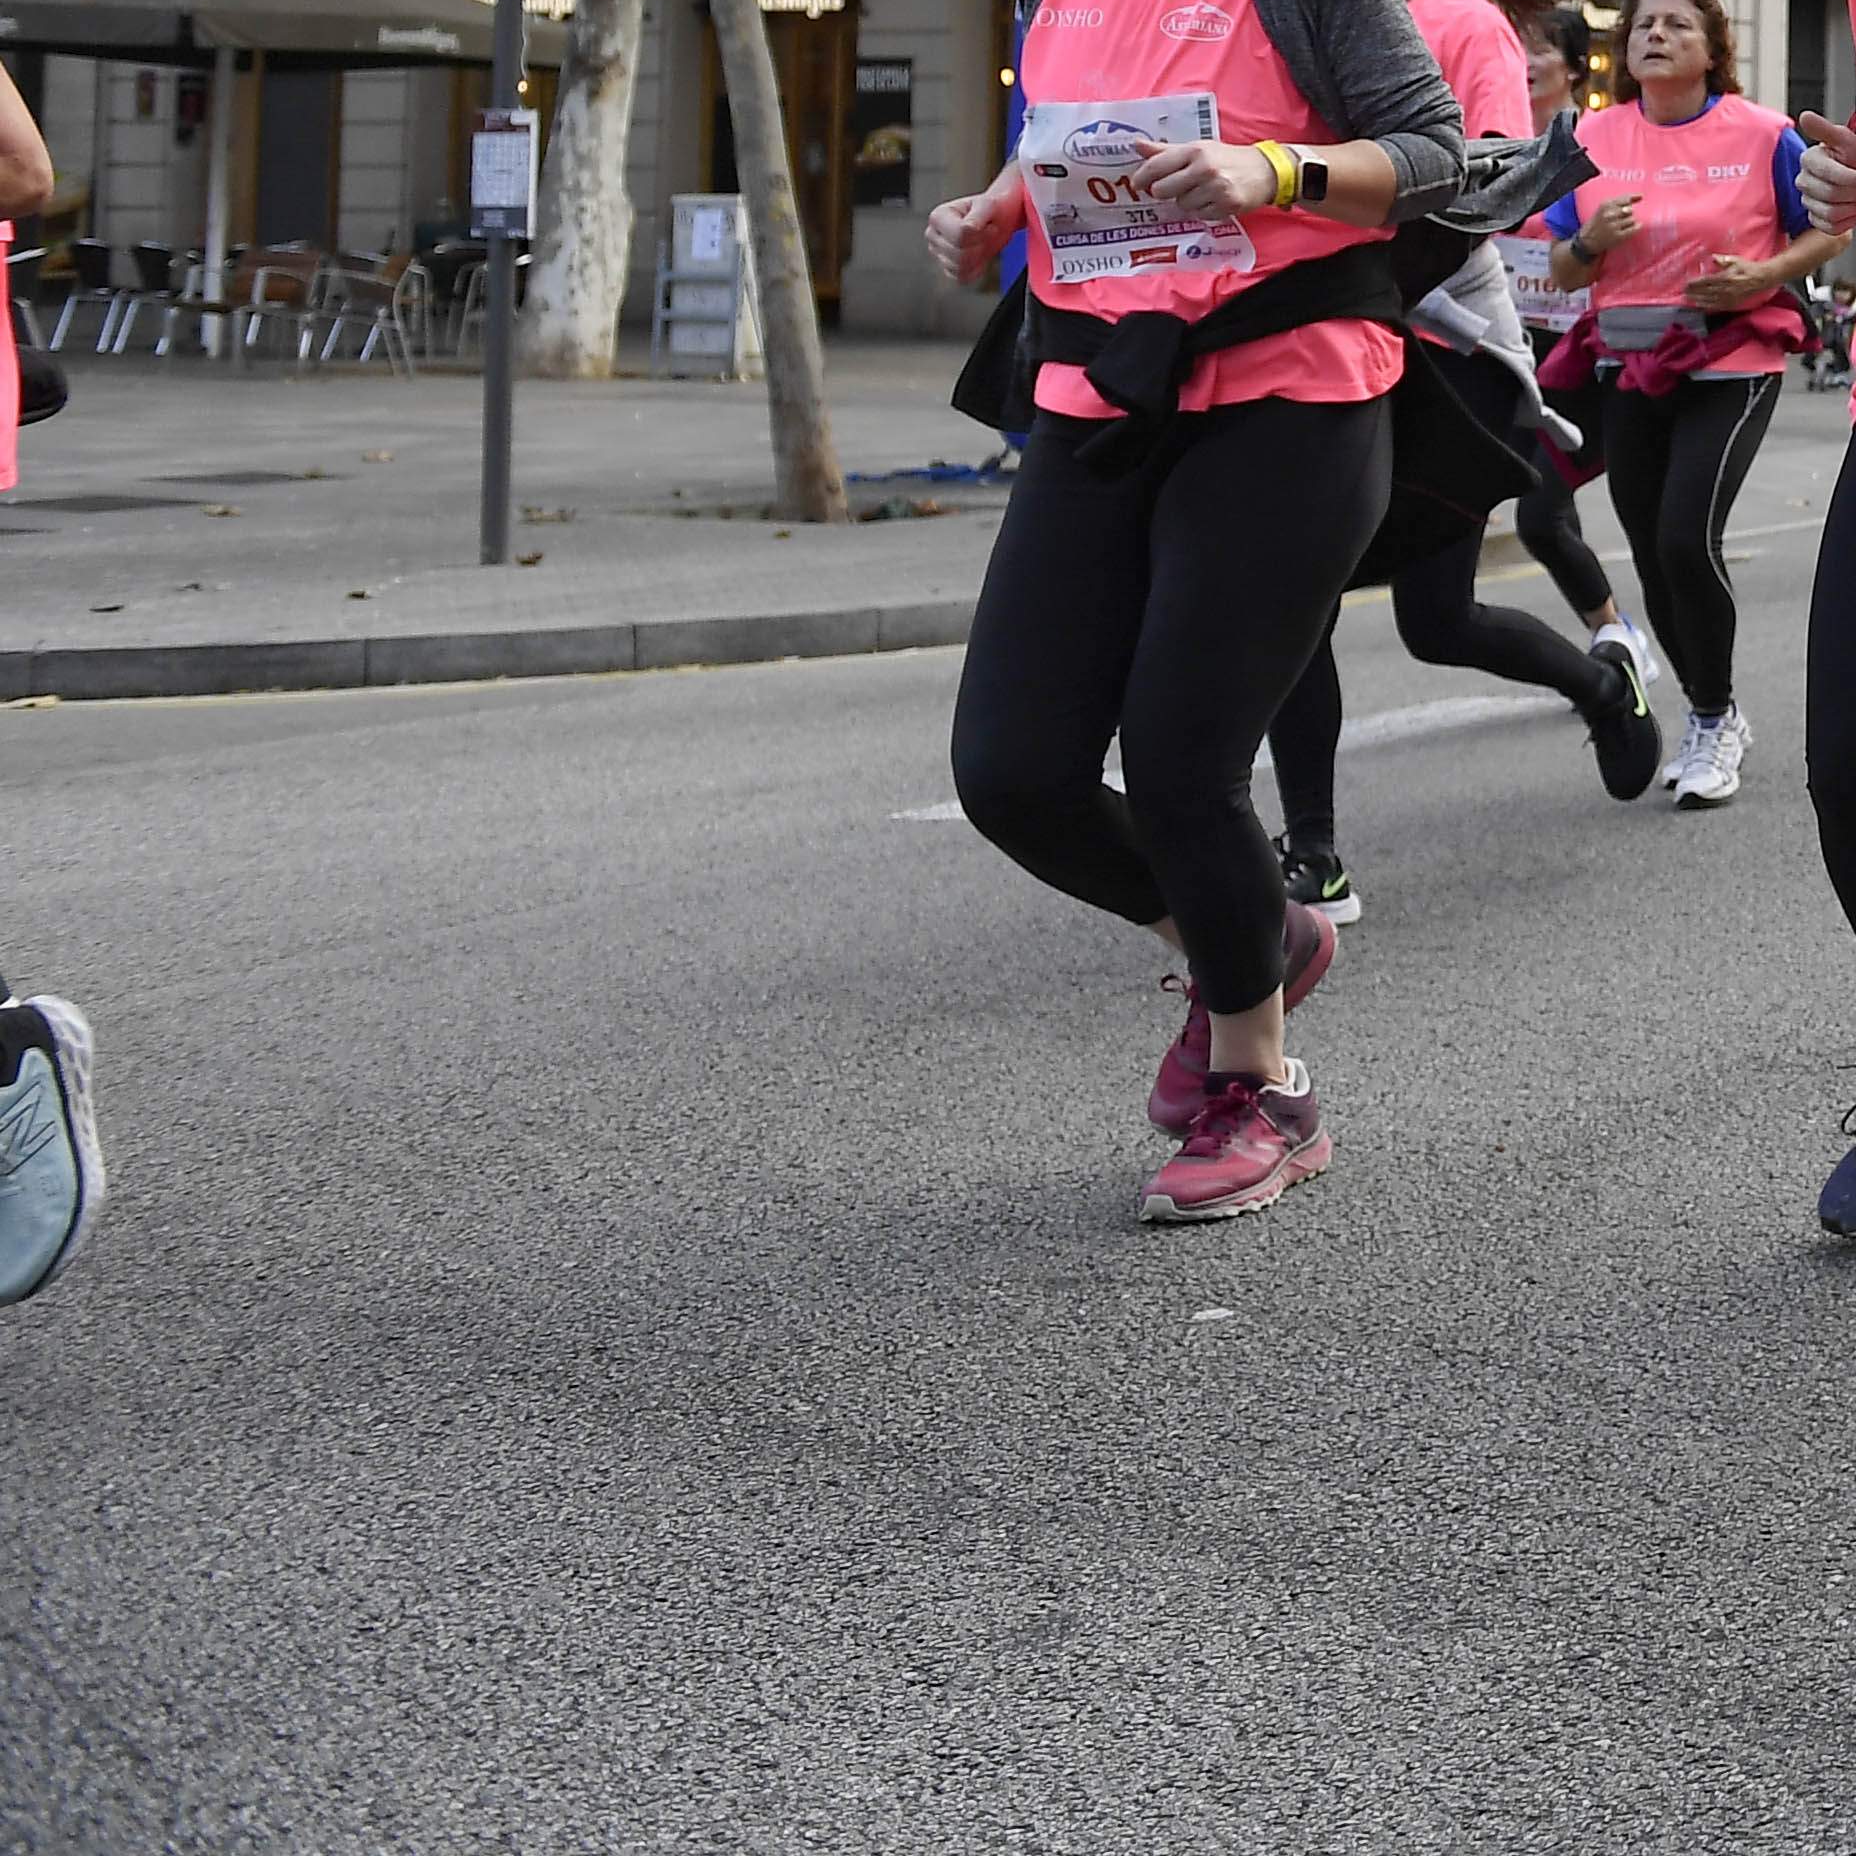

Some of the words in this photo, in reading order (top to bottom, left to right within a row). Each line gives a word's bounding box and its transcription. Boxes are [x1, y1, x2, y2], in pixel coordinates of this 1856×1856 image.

[1071, 141, 1137, 158] ASTURIA
[1707, 163, 1751, 178] DKV
[1125, 208, 1159, 223] 375
[1056, 231, 1089, 247] CURSA
[1090, 231, 1105, 244] DE
[1106, 228, 1128, 242] LES
[1129, 225, 1166, 239] DONES
[1062, 255, 1123, 275] OYSHO
